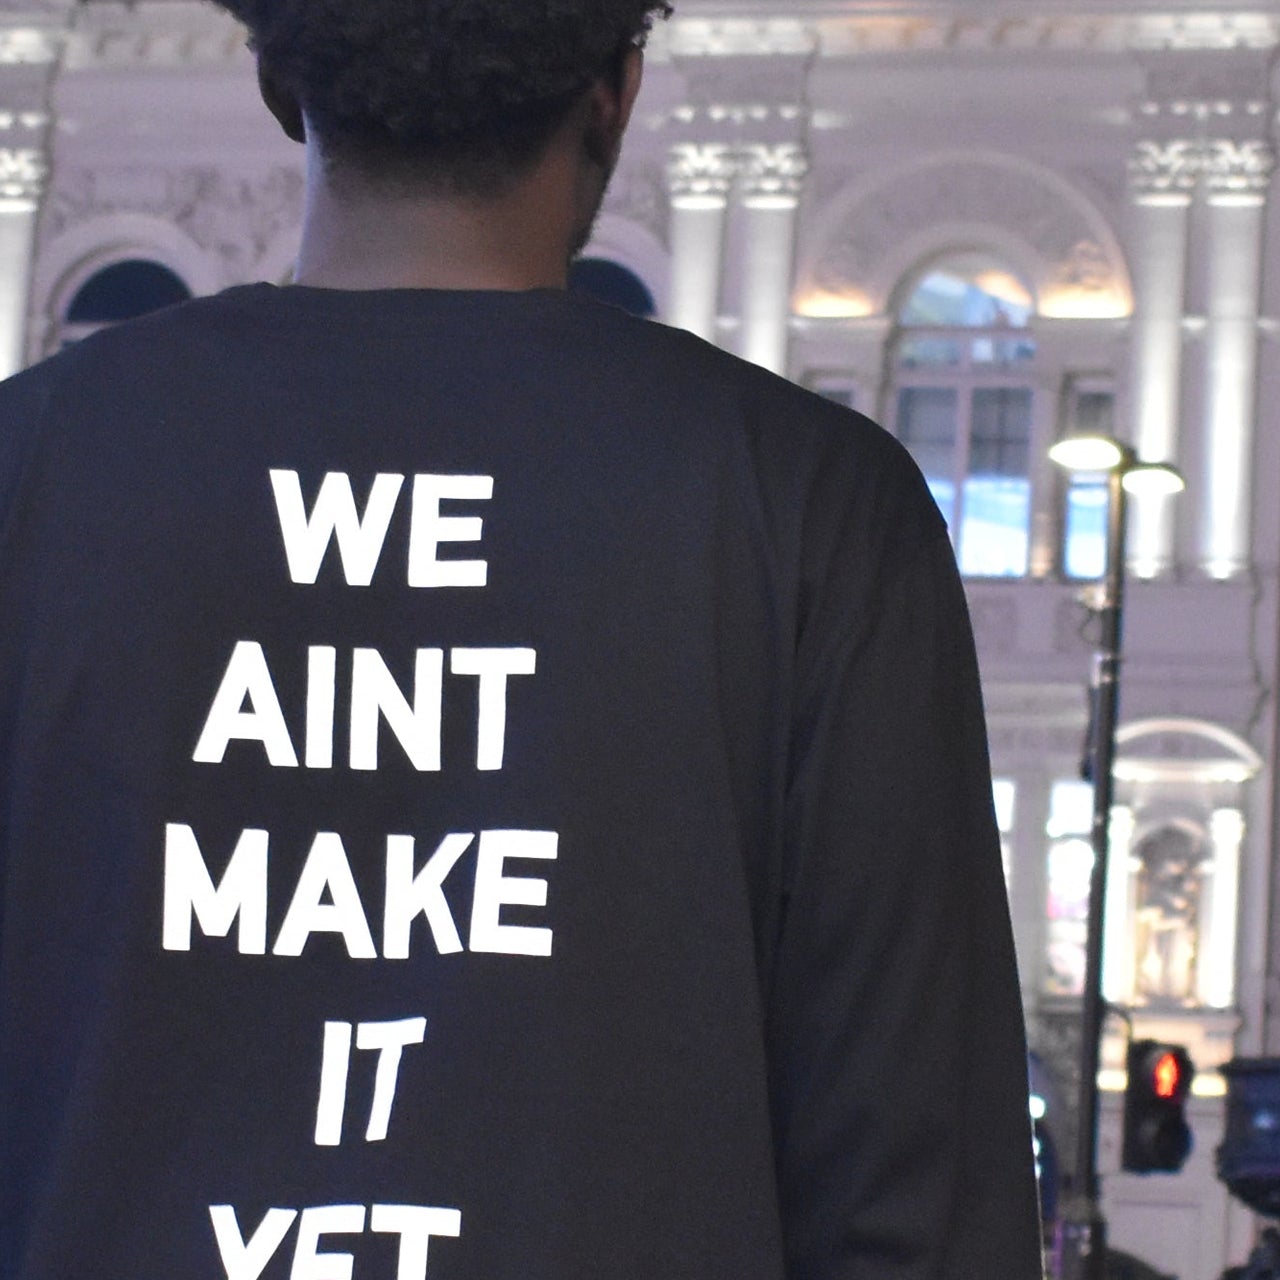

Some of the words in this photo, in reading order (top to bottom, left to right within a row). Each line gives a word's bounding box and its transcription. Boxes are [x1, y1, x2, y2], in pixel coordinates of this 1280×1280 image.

[269, 469, 495, 587] WE
[192, 641, 537, 771] AINT
[163, 823, 559, 959] MAKE
[315, 1017, 428, 1145] IT
